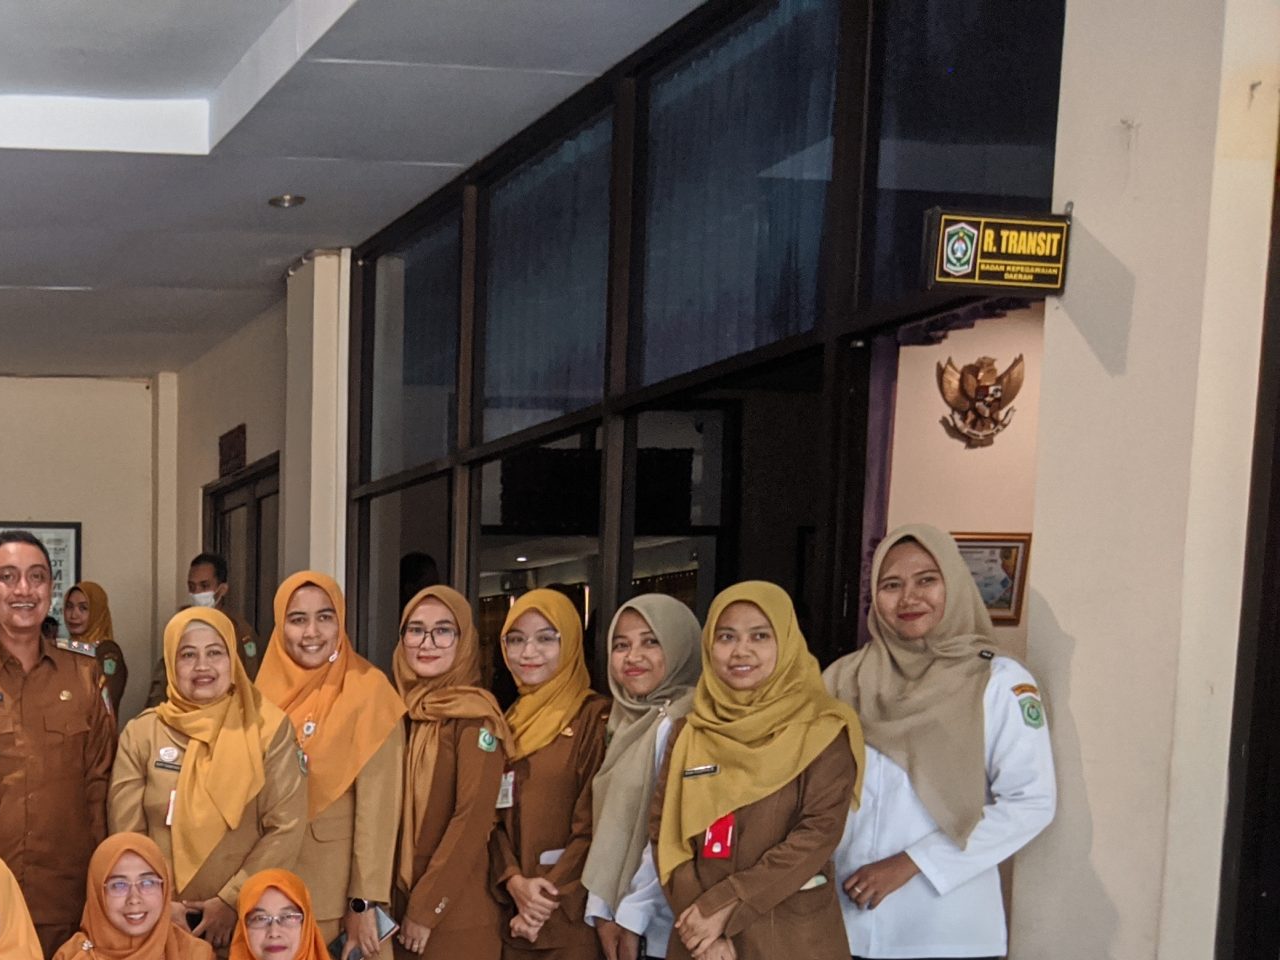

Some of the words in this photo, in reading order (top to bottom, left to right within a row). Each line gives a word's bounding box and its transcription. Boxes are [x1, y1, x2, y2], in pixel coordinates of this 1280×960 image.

[983, 229, 996, 253] R.
[1000, 230, 1061, 256] TRANSIT
[980, 264, 1005, 272] BADAN
[1004, 273, 1033, 281] DAERAH
